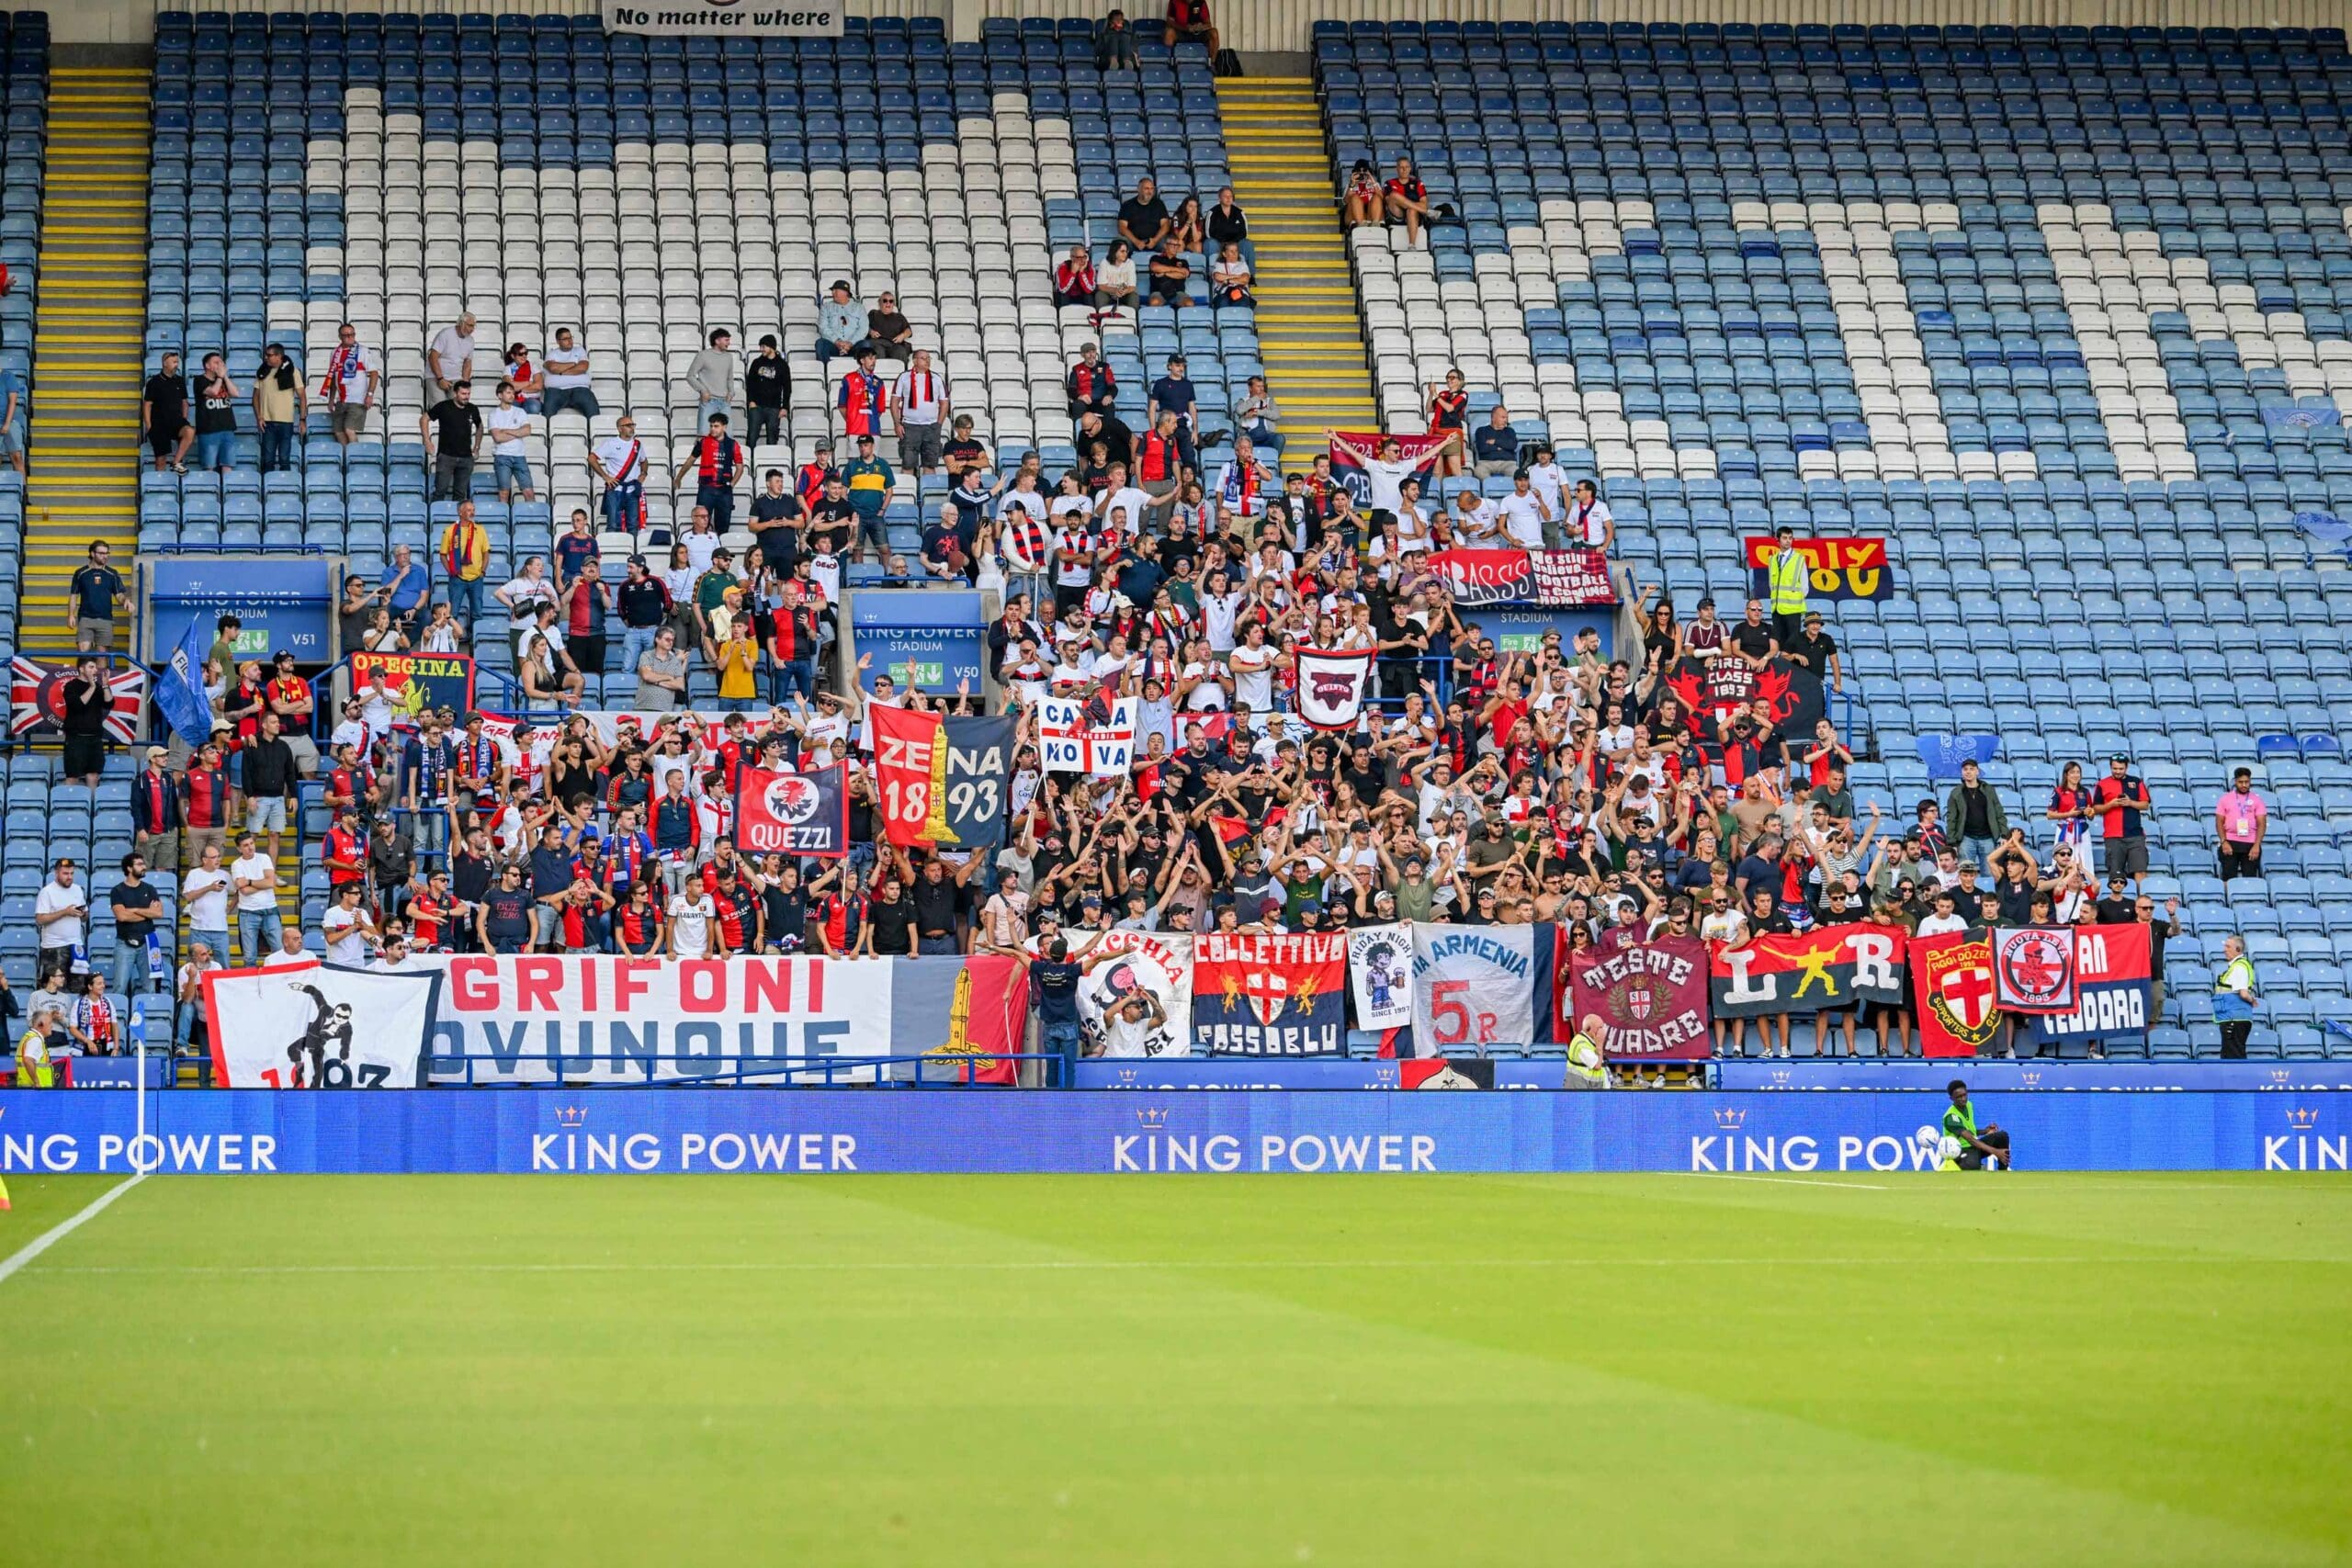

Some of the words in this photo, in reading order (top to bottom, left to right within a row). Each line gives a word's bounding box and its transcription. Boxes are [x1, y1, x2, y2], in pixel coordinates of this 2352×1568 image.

[616, 8, 650, 26] No
[657, 10, 746, 26] matter
[753, 9, 831, 27] where
[1557, 552, 1587, 565] still
[1810, 568, 1880, 596] OU
[214, 608, 267, 619] STADIUM
[1500, 613, 1553, 624] STADIUM
[291, 634, 315, 645] V51
[889, 641, 943, 652] STADIUM
[954, 666, 979, 678] V50
[1708, 671, 1753, 684] CLASS
[751, 824, 831, 849] QUEZZI
[1193, 932, 1347, 964] COLLETTIVO
[1351, 931, 1382, 965] FRIDAY
[1430, 935, 1529, 978] ARMENIA
[2003, 932, 2041, 958] NUOVA
[2043, 932, 2069, 958] LEVA
[449, 956, 823, 1013] GRIFONI
[1582, 948, 1693, 991] TESTE
[1371, 1009, 1392, 1018] SINCE
[1933, 997, 1969, 1038] SUPPORTERS
[1604, 1009, 1704, 1054] UADRE
[435, 1020, 851, 1075] OVUNQUE
[99, 1134, 277, 1171] POWER
[533, 1134, 661, 1171] KING
[682, 1134, 858, 1171] POWER
[1114, 1134, 1242, 1173] KING
[1261, 1134, 1438, 1173] POWER
[1690, 1135, 1819, 1172] KING
[1839, 1135, 1999, 1172] POW
